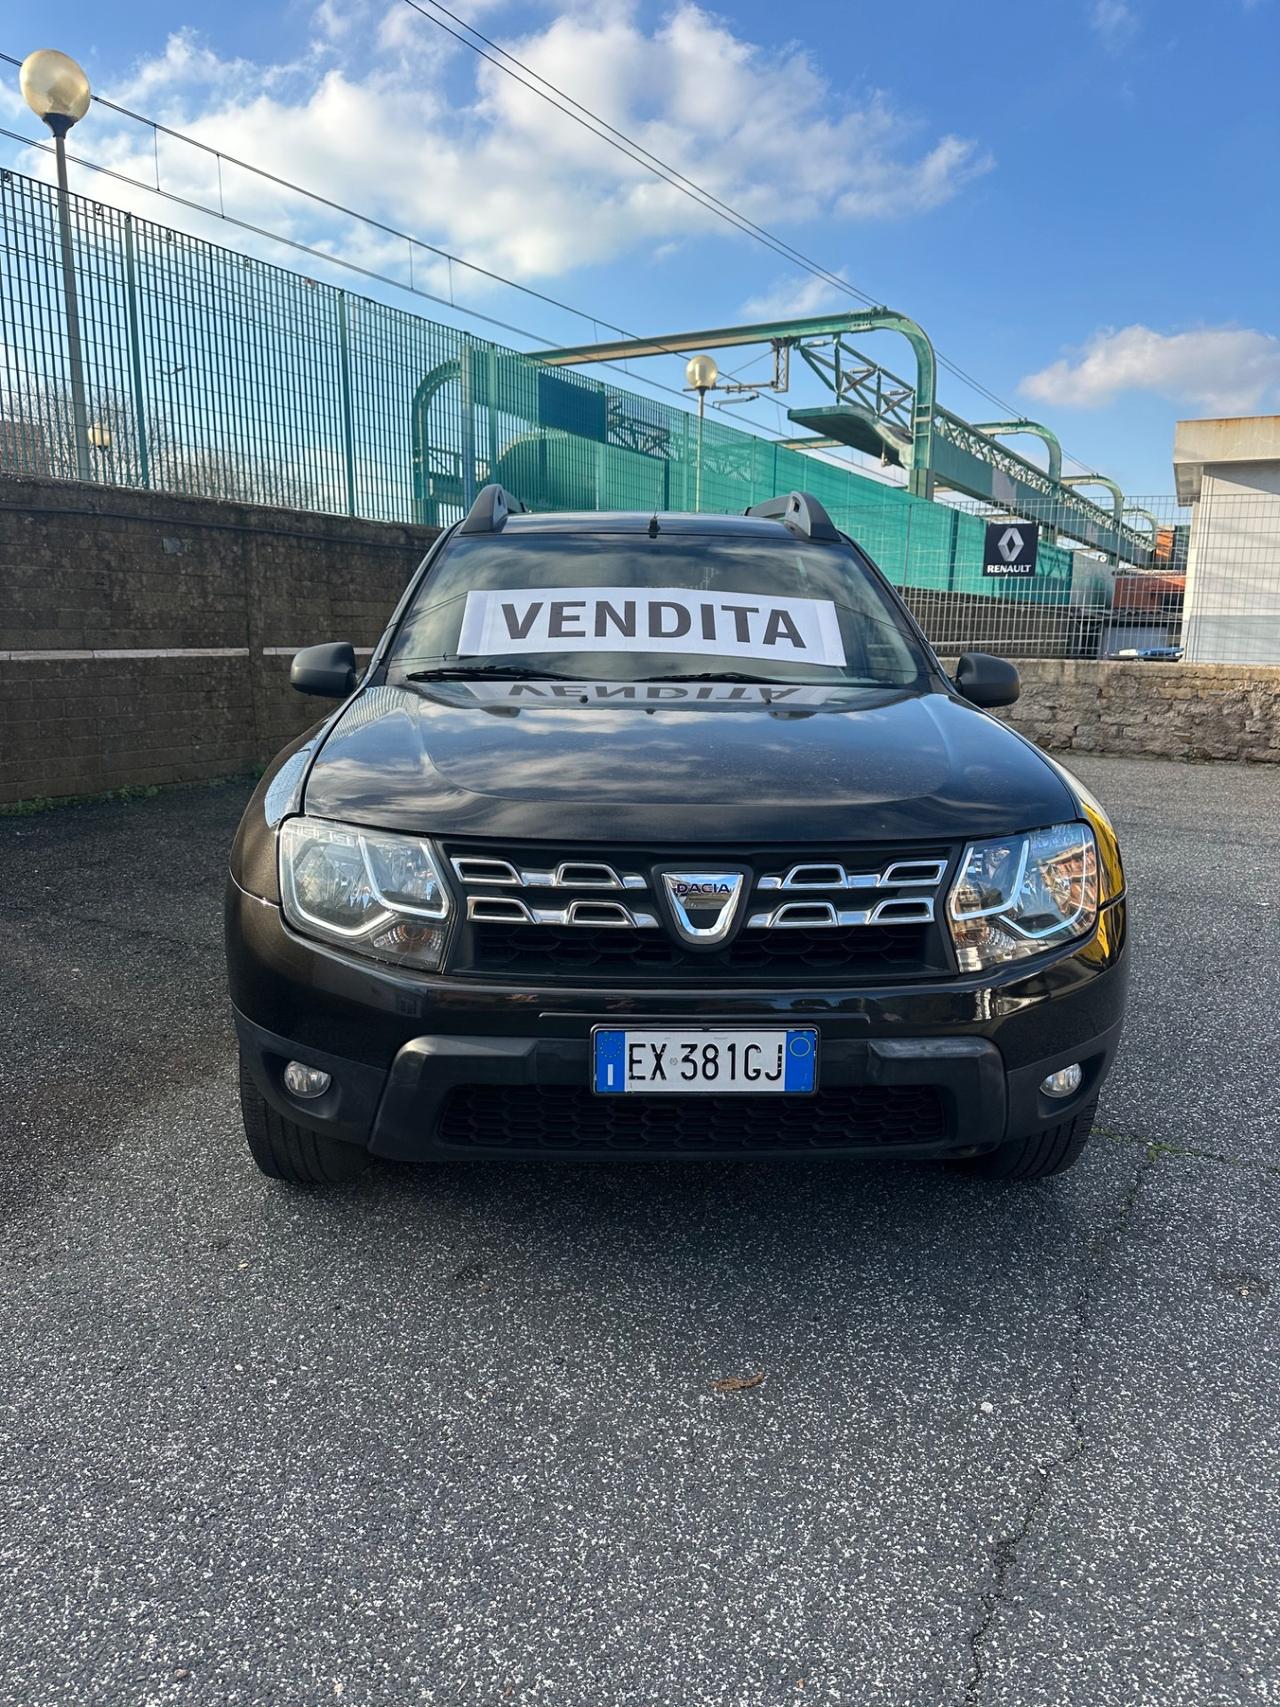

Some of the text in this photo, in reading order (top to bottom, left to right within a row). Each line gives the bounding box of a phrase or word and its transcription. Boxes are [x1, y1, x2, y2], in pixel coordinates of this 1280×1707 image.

[987, 564, 1032, 573] RENAULT
[501, 600, 807, 649] VENDITA
[676, 883, 730, 893] DACIA
[628, 1043, 783, 1081] EX 381GJ
